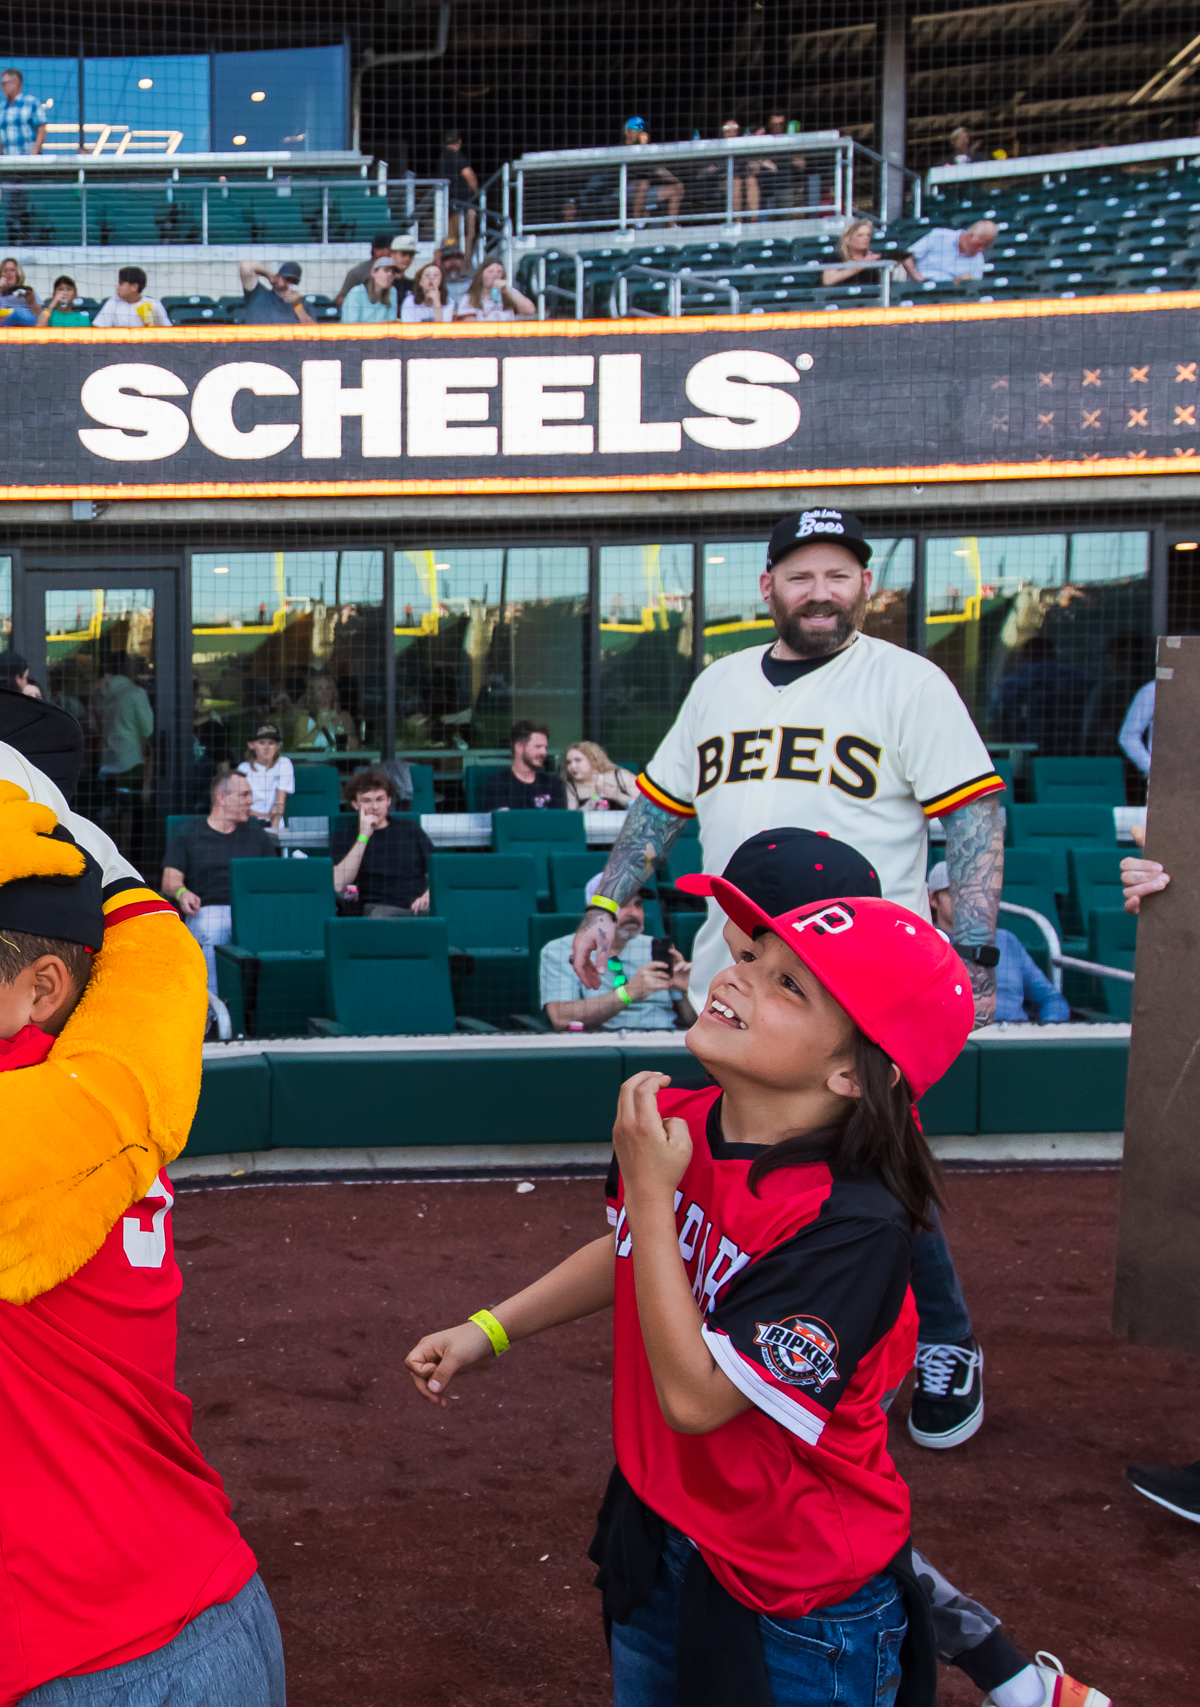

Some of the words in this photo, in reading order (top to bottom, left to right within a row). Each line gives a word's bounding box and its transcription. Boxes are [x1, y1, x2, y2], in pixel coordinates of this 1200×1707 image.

[802, 511, 821, 519] Salt
[821, 508, 842, 519] Lake
[795, 518, 844, 538] Bees
[695, 725, 883, 801] BEES
[795, 1325, 828, 1349] CAL
[765, 1326, 833, 1378] RIPKEN
[772, 1350, 810, 1377] BASEBALL
